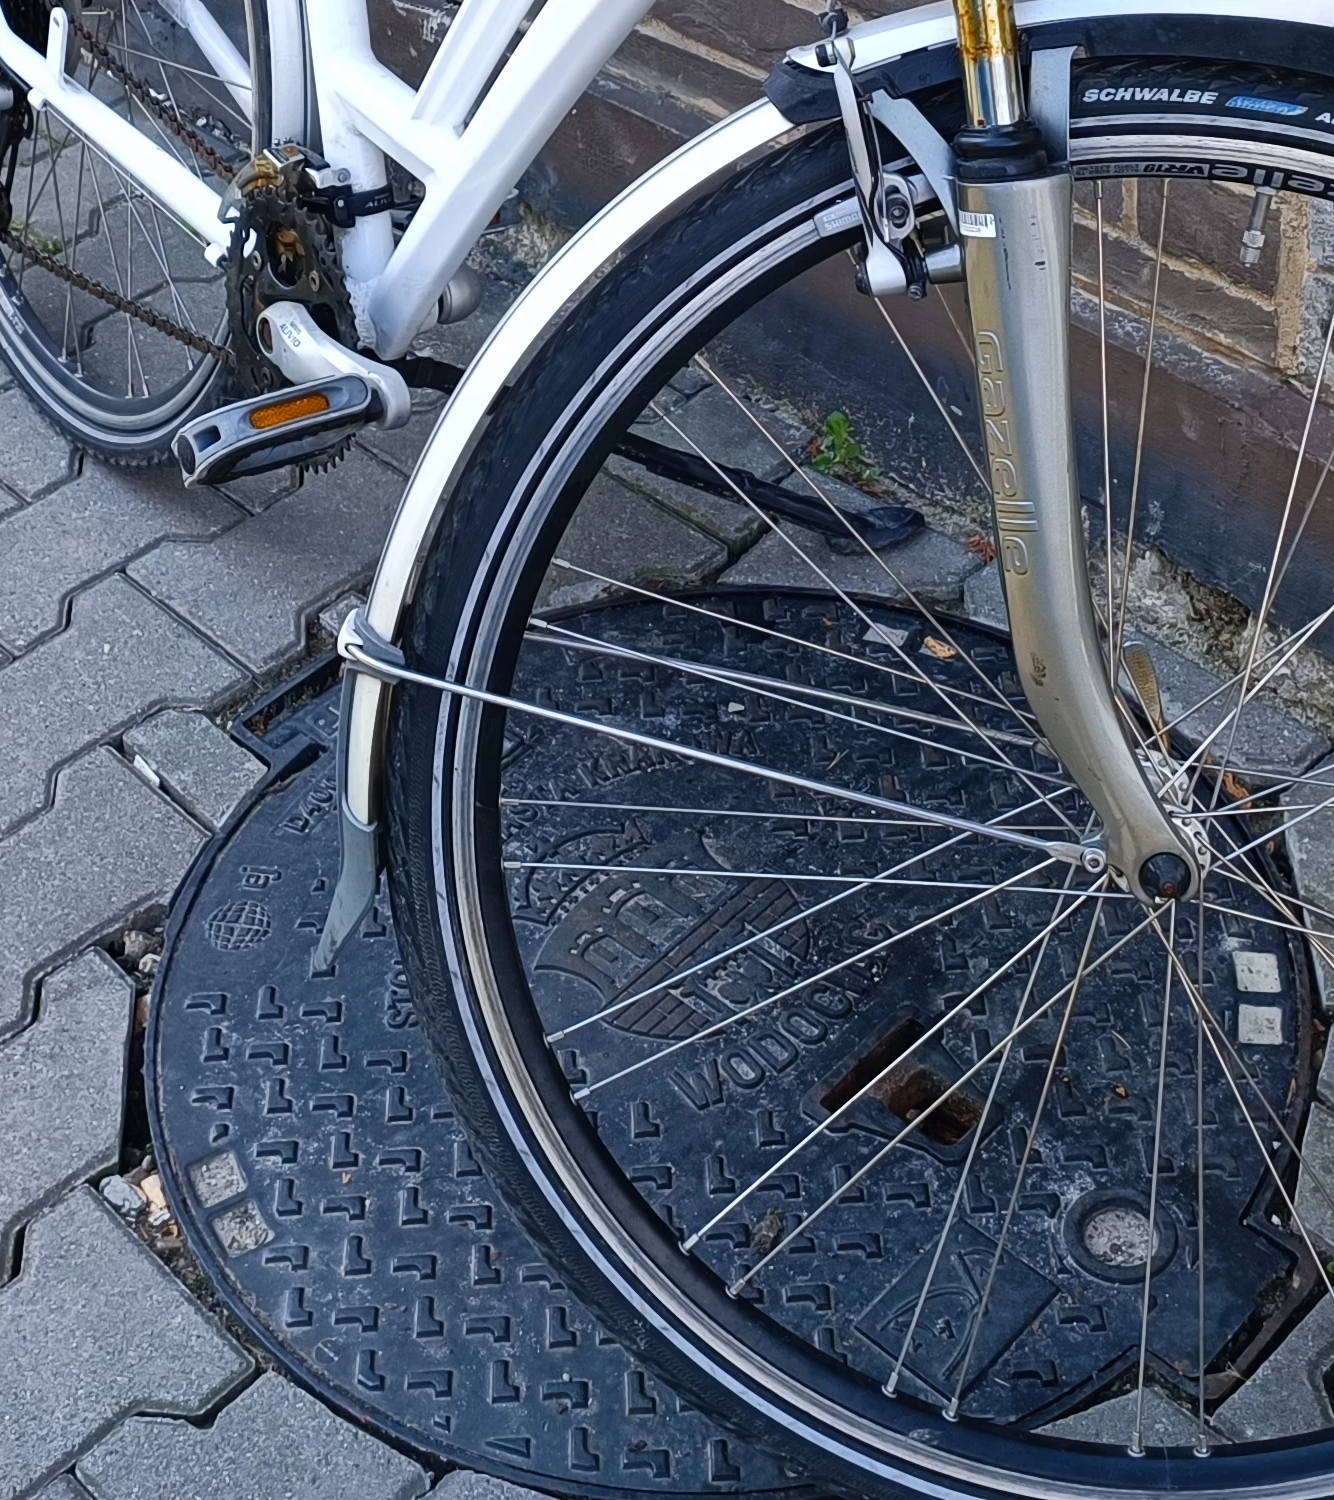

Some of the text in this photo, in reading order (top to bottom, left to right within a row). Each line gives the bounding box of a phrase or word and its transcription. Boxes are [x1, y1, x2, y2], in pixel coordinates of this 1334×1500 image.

[1083, 88, 1219, 104] SCHWALBE
[1143, 164, 1205, 175] VR19
[976, 331, 1039, 576] Gazelle
